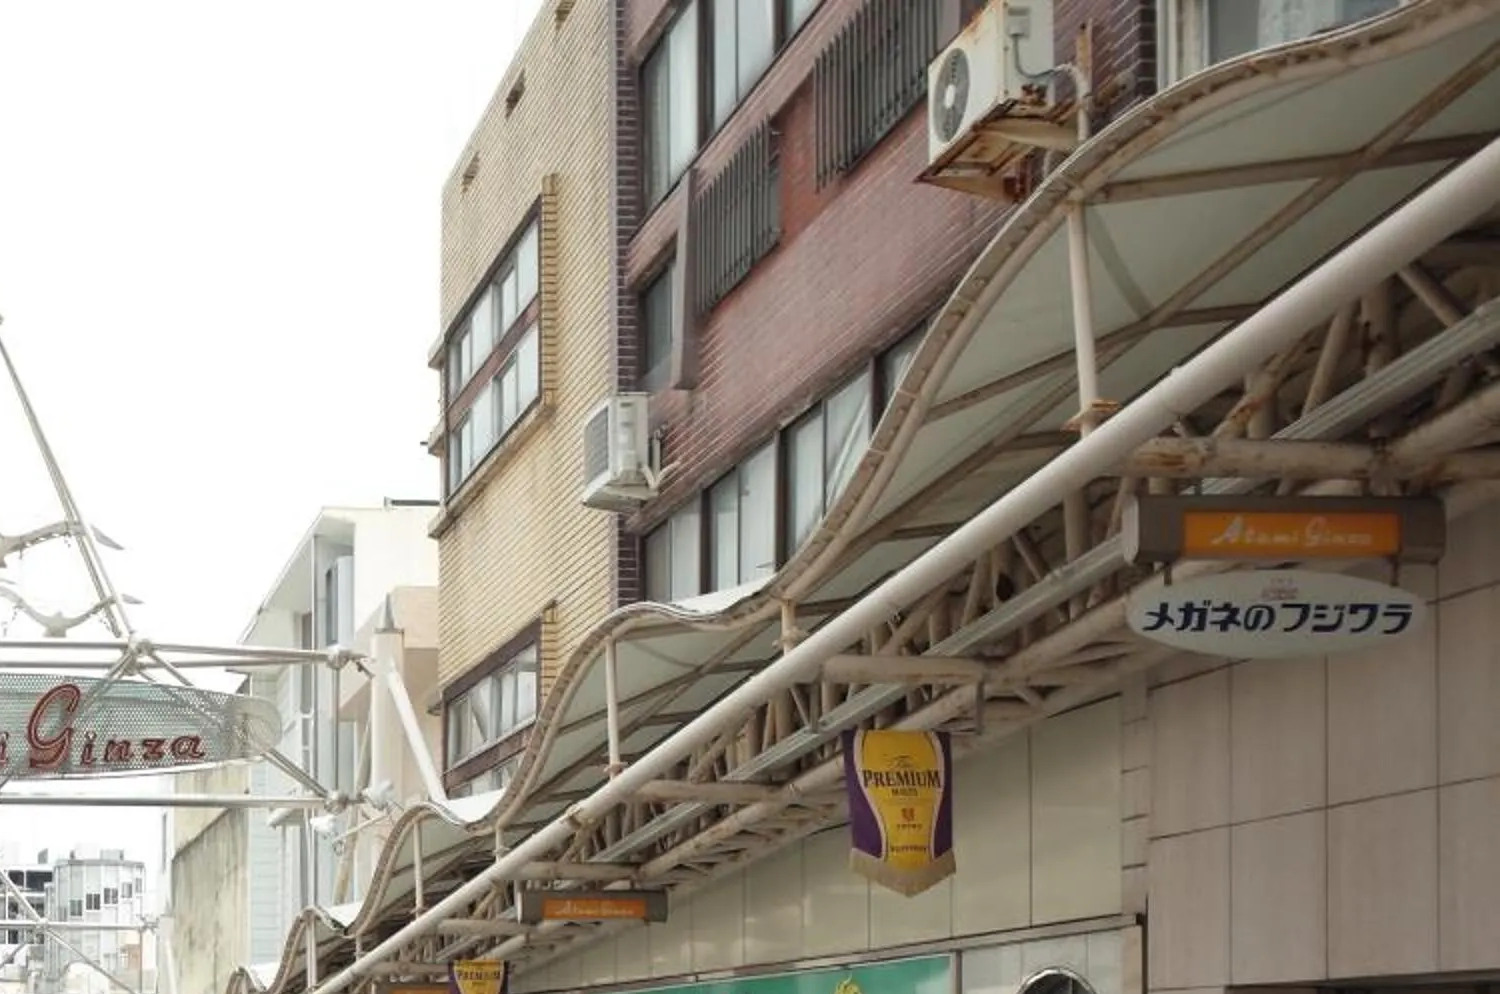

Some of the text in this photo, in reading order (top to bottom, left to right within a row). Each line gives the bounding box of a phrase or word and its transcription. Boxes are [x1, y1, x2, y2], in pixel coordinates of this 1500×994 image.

[1211, 515, 1372, 546] Atami Ginza
[1143, 600, 1413, 634] メガネのフジワラ
[26, 683, 206, 769] Ginza
[863, 769, 942, 789] PREMIUM
